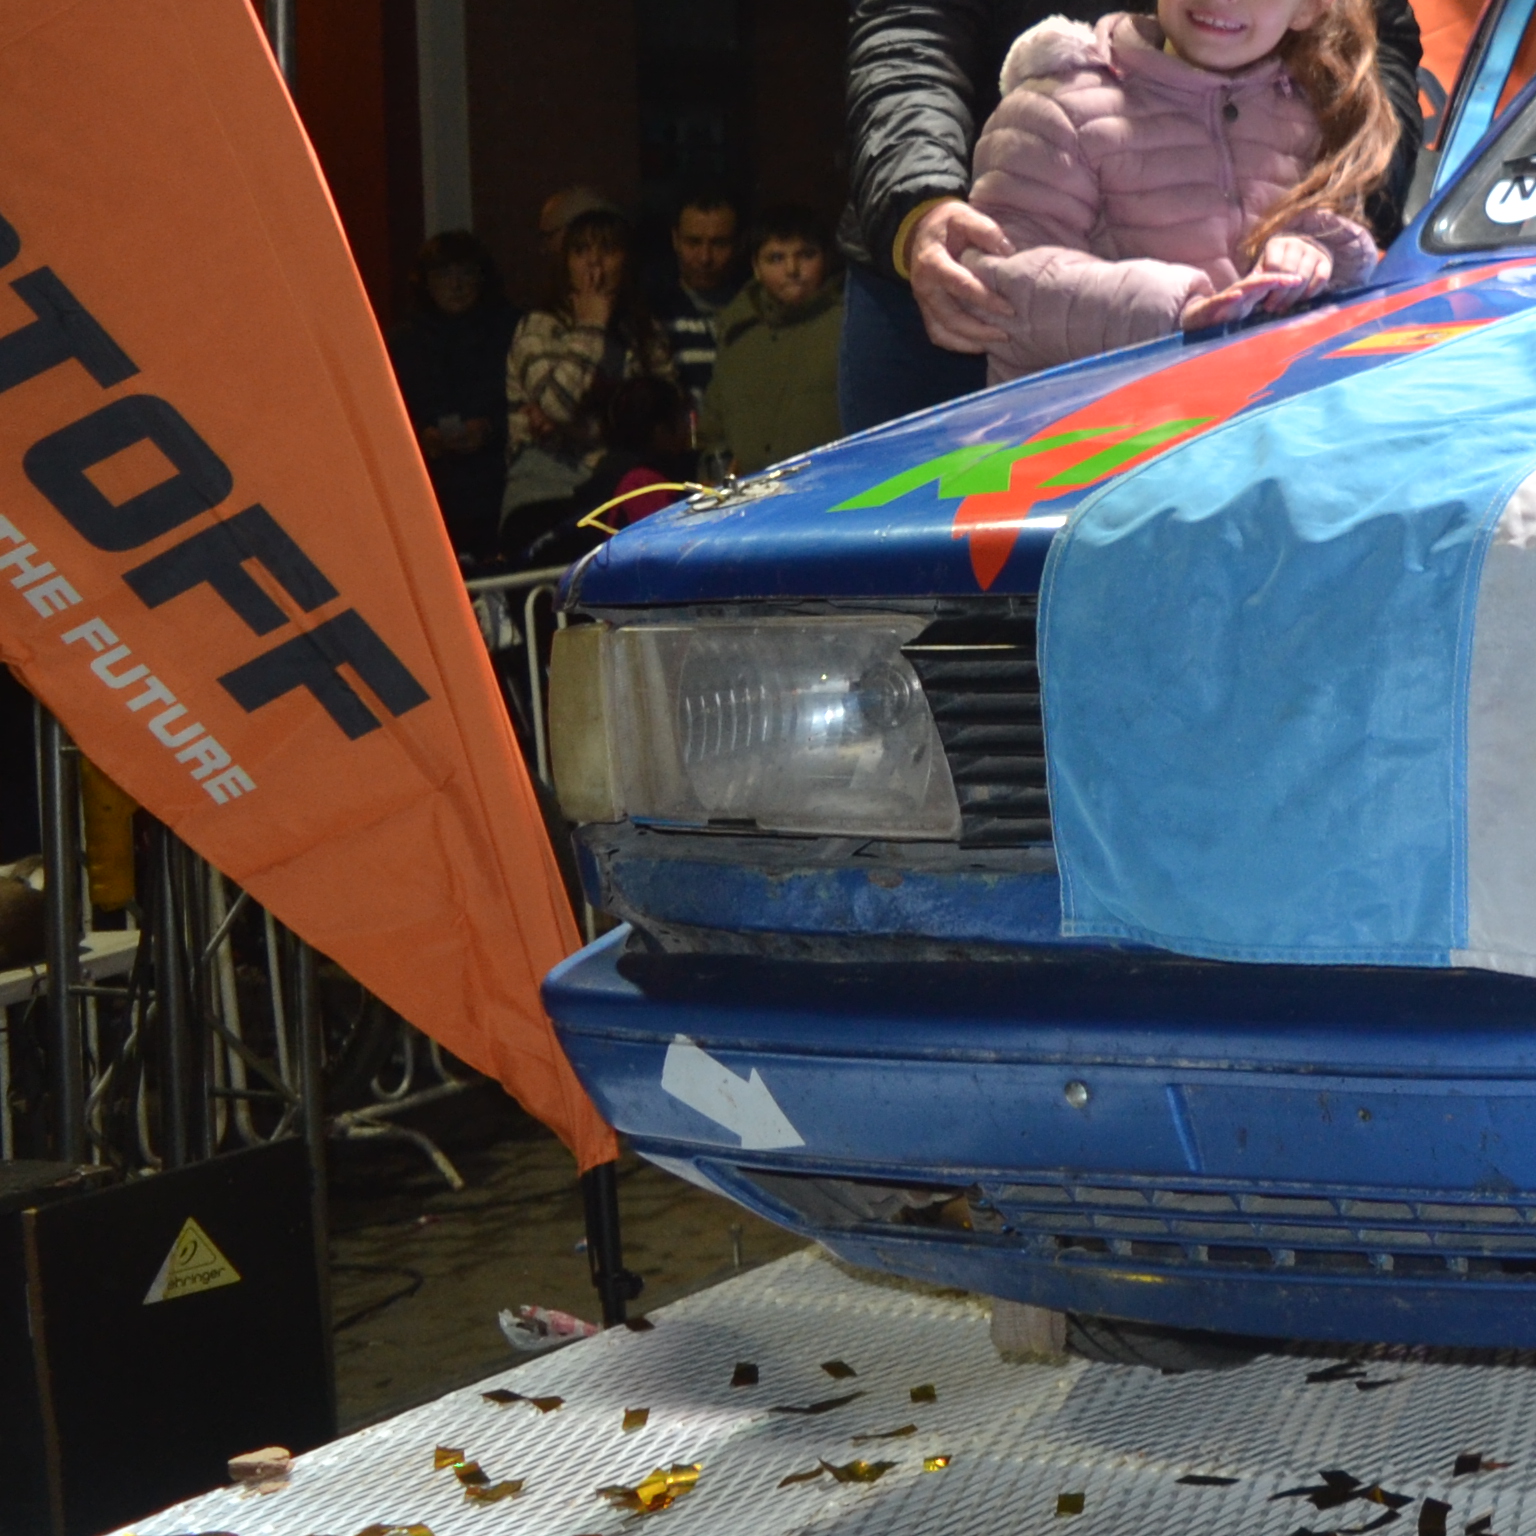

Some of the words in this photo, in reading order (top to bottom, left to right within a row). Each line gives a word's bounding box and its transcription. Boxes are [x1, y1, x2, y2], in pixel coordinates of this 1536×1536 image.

[0, 211, 430, 740] TOFF
[60, 616, 257, 805] FUTURE
[164, 1266, 226, 1291] ehringer
